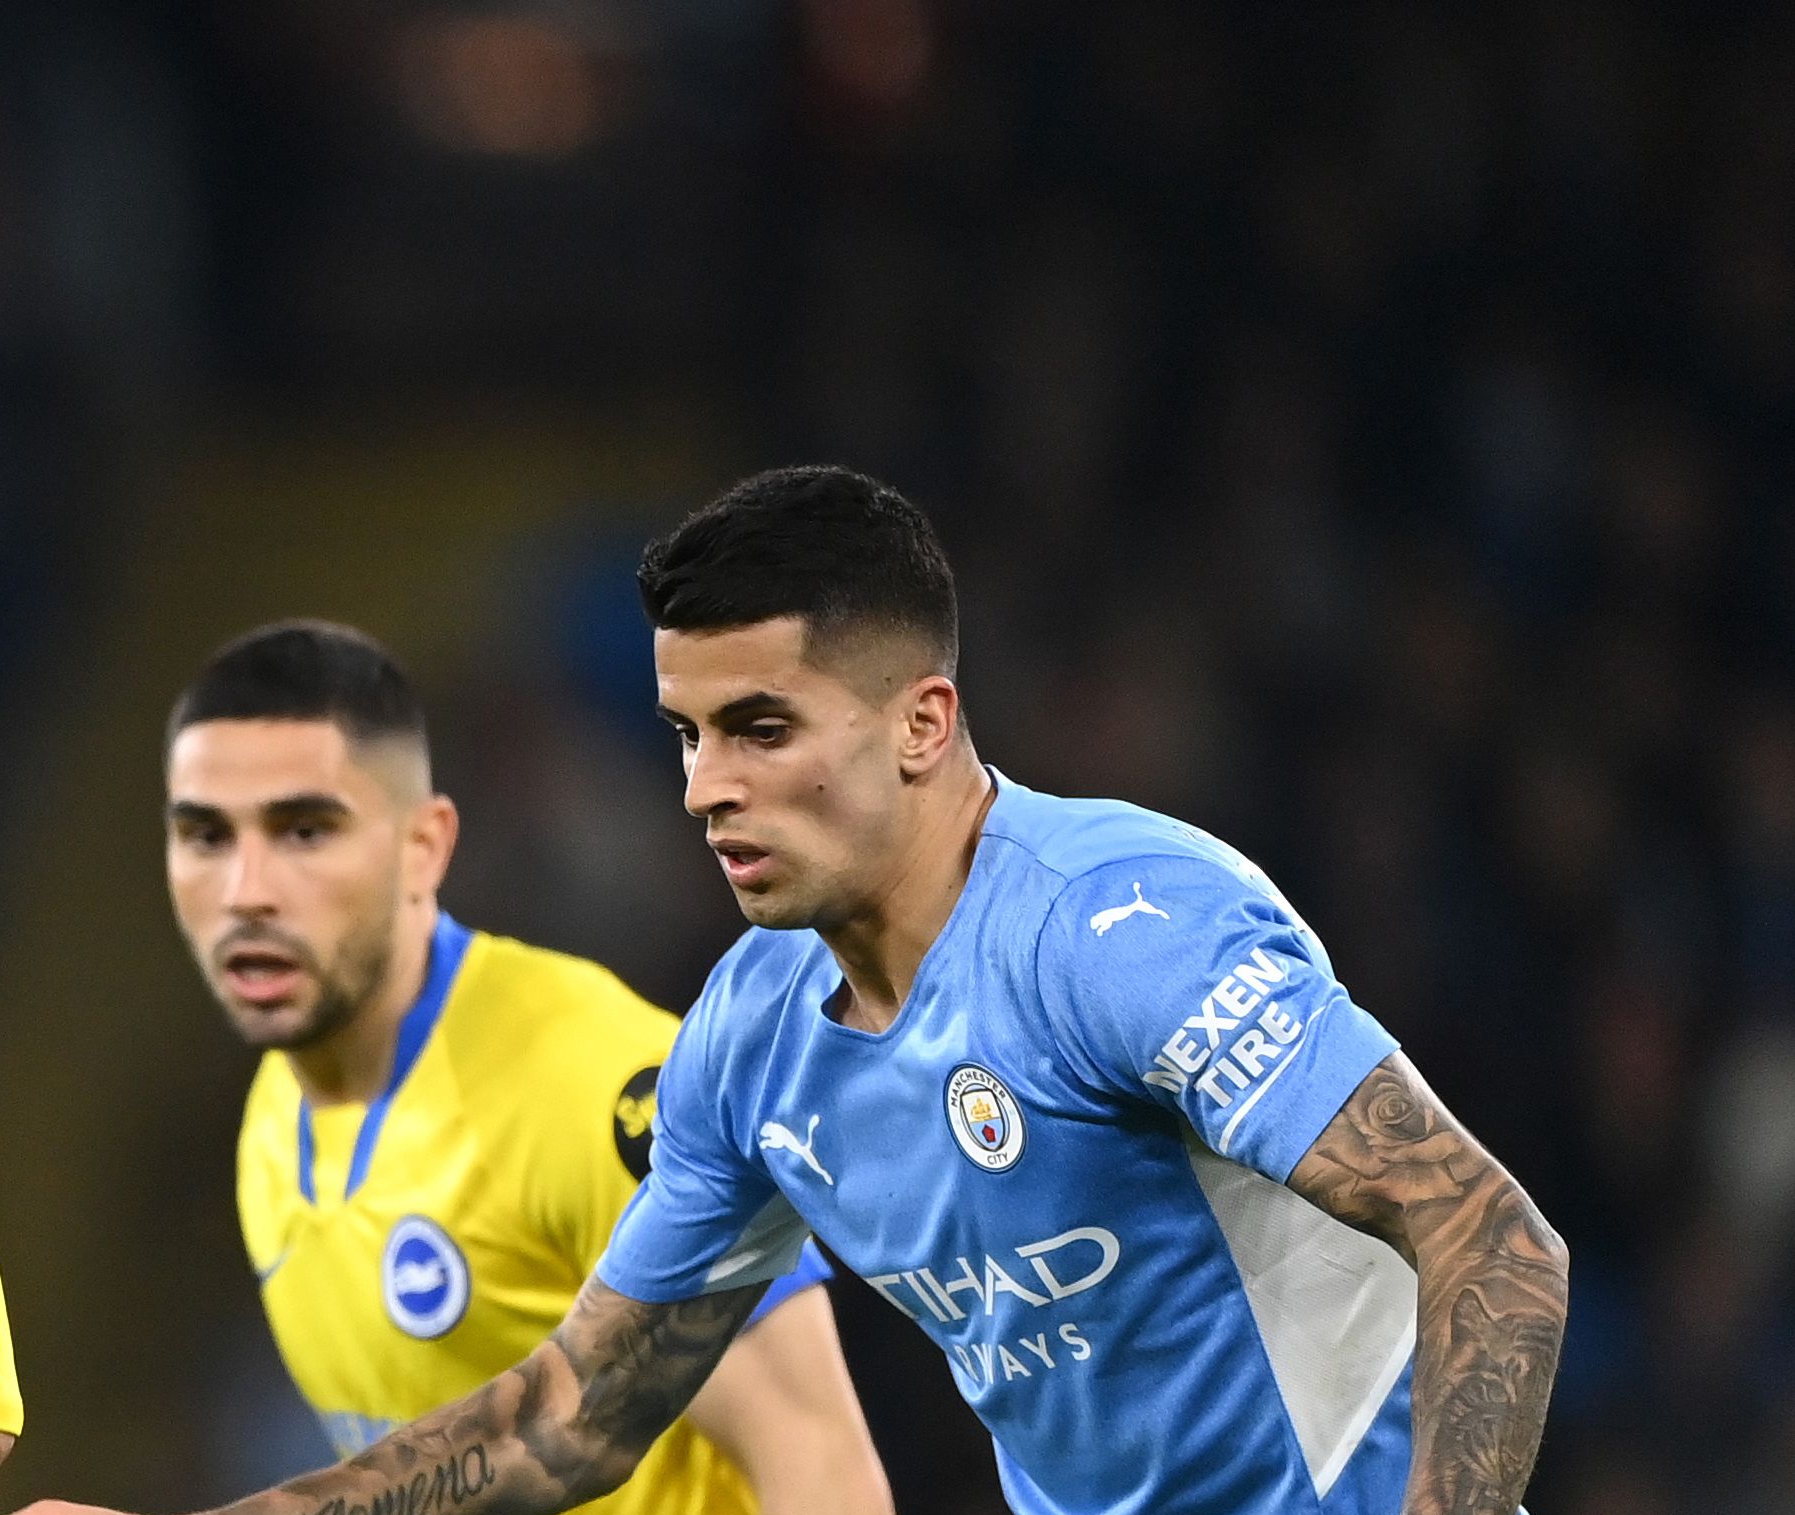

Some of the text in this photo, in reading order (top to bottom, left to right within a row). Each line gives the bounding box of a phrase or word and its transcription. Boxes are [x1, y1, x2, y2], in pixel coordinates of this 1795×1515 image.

[1142, 947, 1286, 1094] NEXEN
[1193, 1000, 1303, 1108] TIRE
[950, 1071, 1006, 1108] MANCHESTER
[986, 1152, 1008, 1165] CITY
[866, 1226, 1121, 1323] TIHAD
[952, 1322, 1092, 1385] RWAYS
